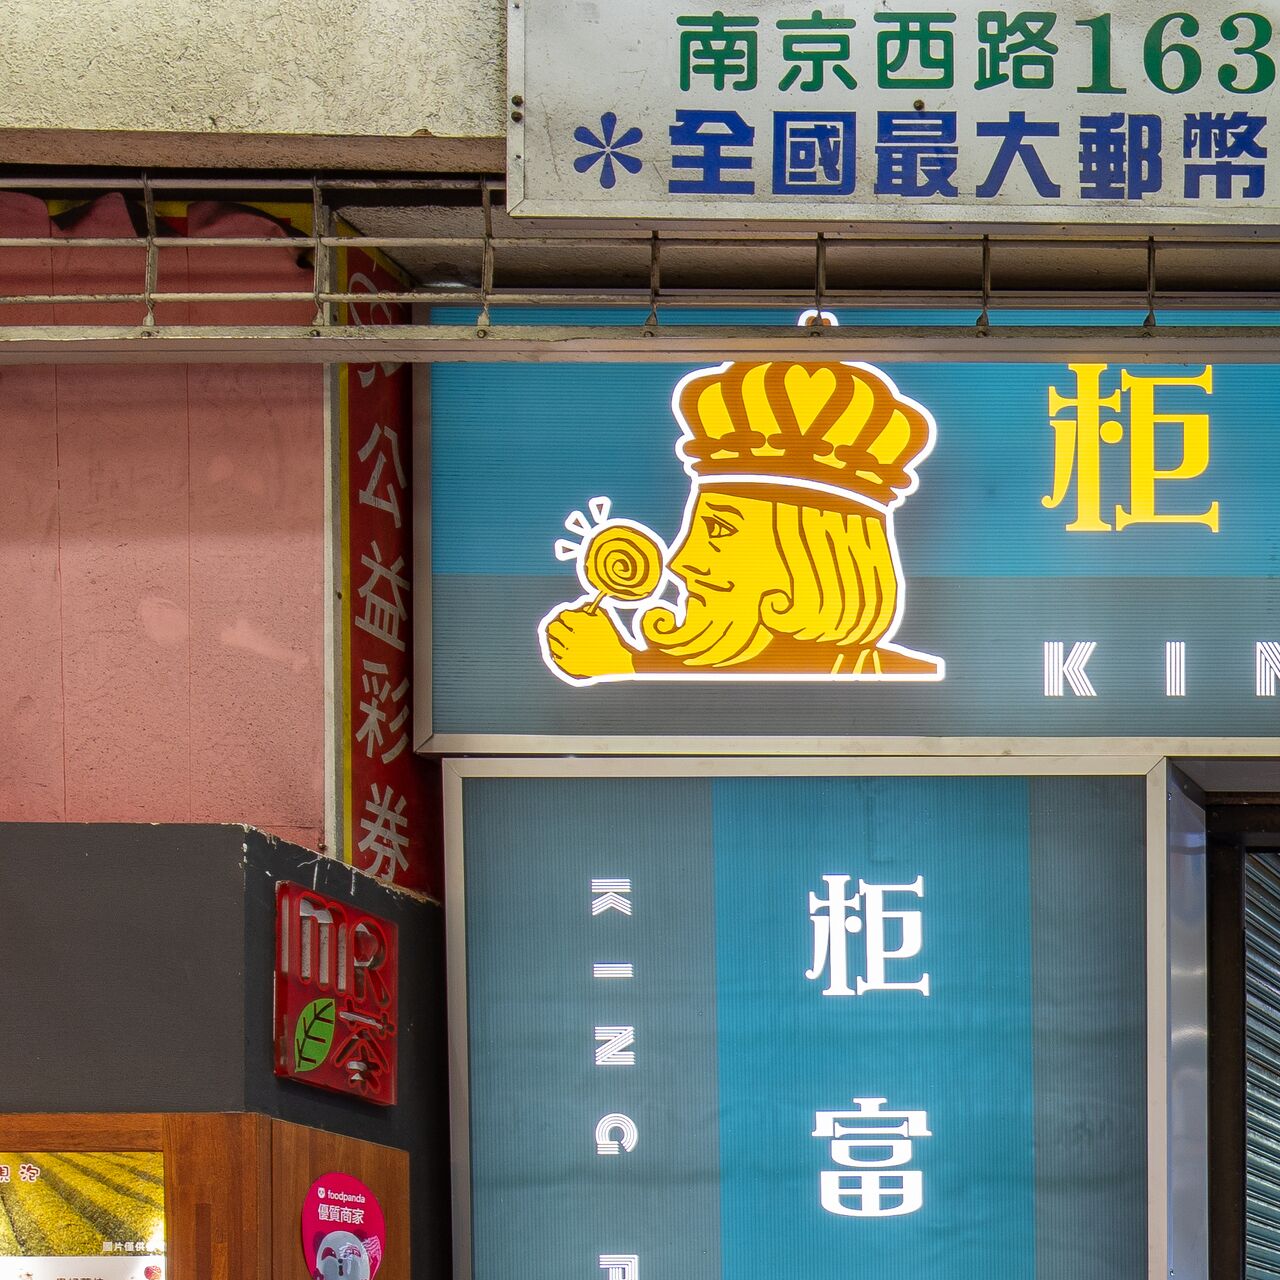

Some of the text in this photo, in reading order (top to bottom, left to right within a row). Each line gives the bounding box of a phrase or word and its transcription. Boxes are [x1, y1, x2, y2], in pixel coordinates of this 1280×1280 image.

[355, 425, 410, 879] 公益彩券
[591, 878, 639, 1155] KING
[318, 1203, 365, 1225] 優質商家
[327, 1189, 366, 1203] foodpanda
